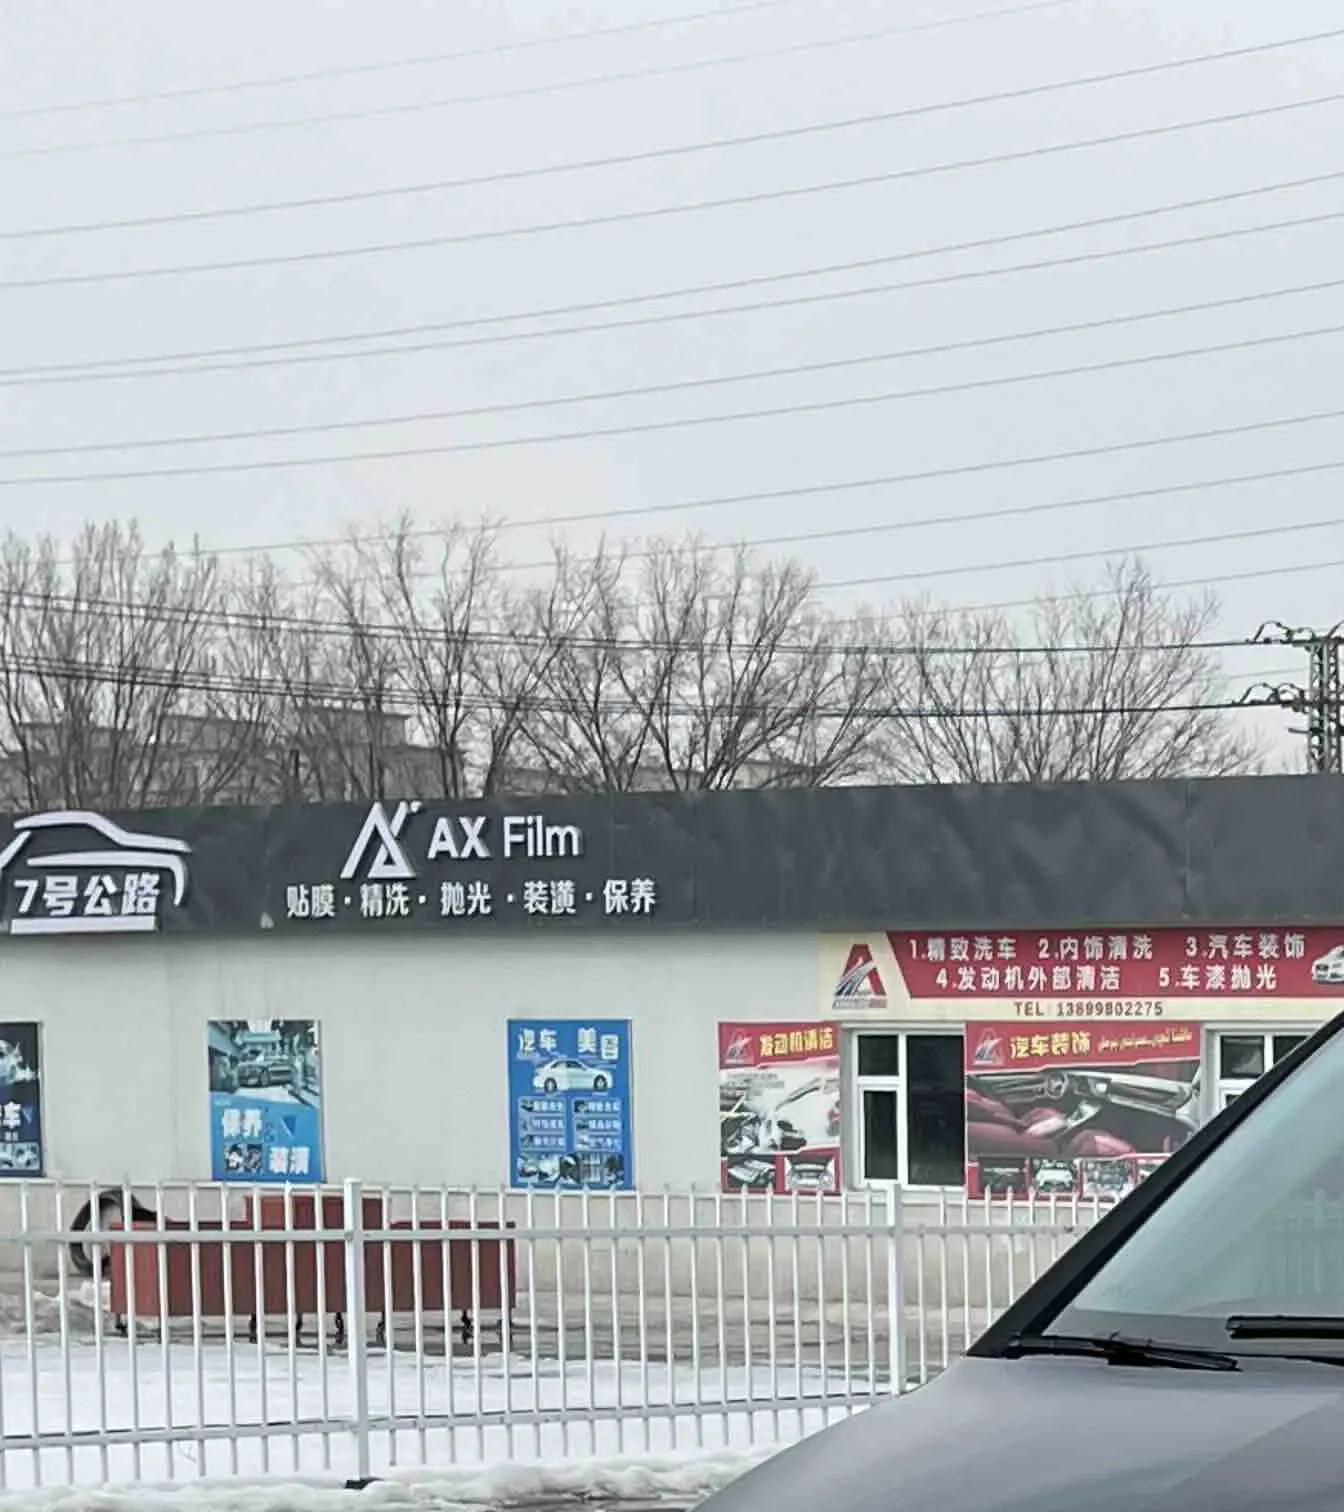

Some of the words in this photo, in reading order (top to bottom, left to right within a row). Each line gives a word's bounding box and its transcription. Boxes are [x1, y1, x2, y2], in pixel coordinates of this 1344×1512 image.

[427, 816, 491, 860] AX
[503, 815, 582, 858] Film
[14, 872, 160, 917] 7号公路
[1038, 935, 1153, 961] 2.内饰清洗
[1186, 933, 1305, 960] 3.汽车装饰
[936, 967, 1120, 992] 4.发动机外部清洁
[1159, 965, 1277, 990] 5.车漆抛光
